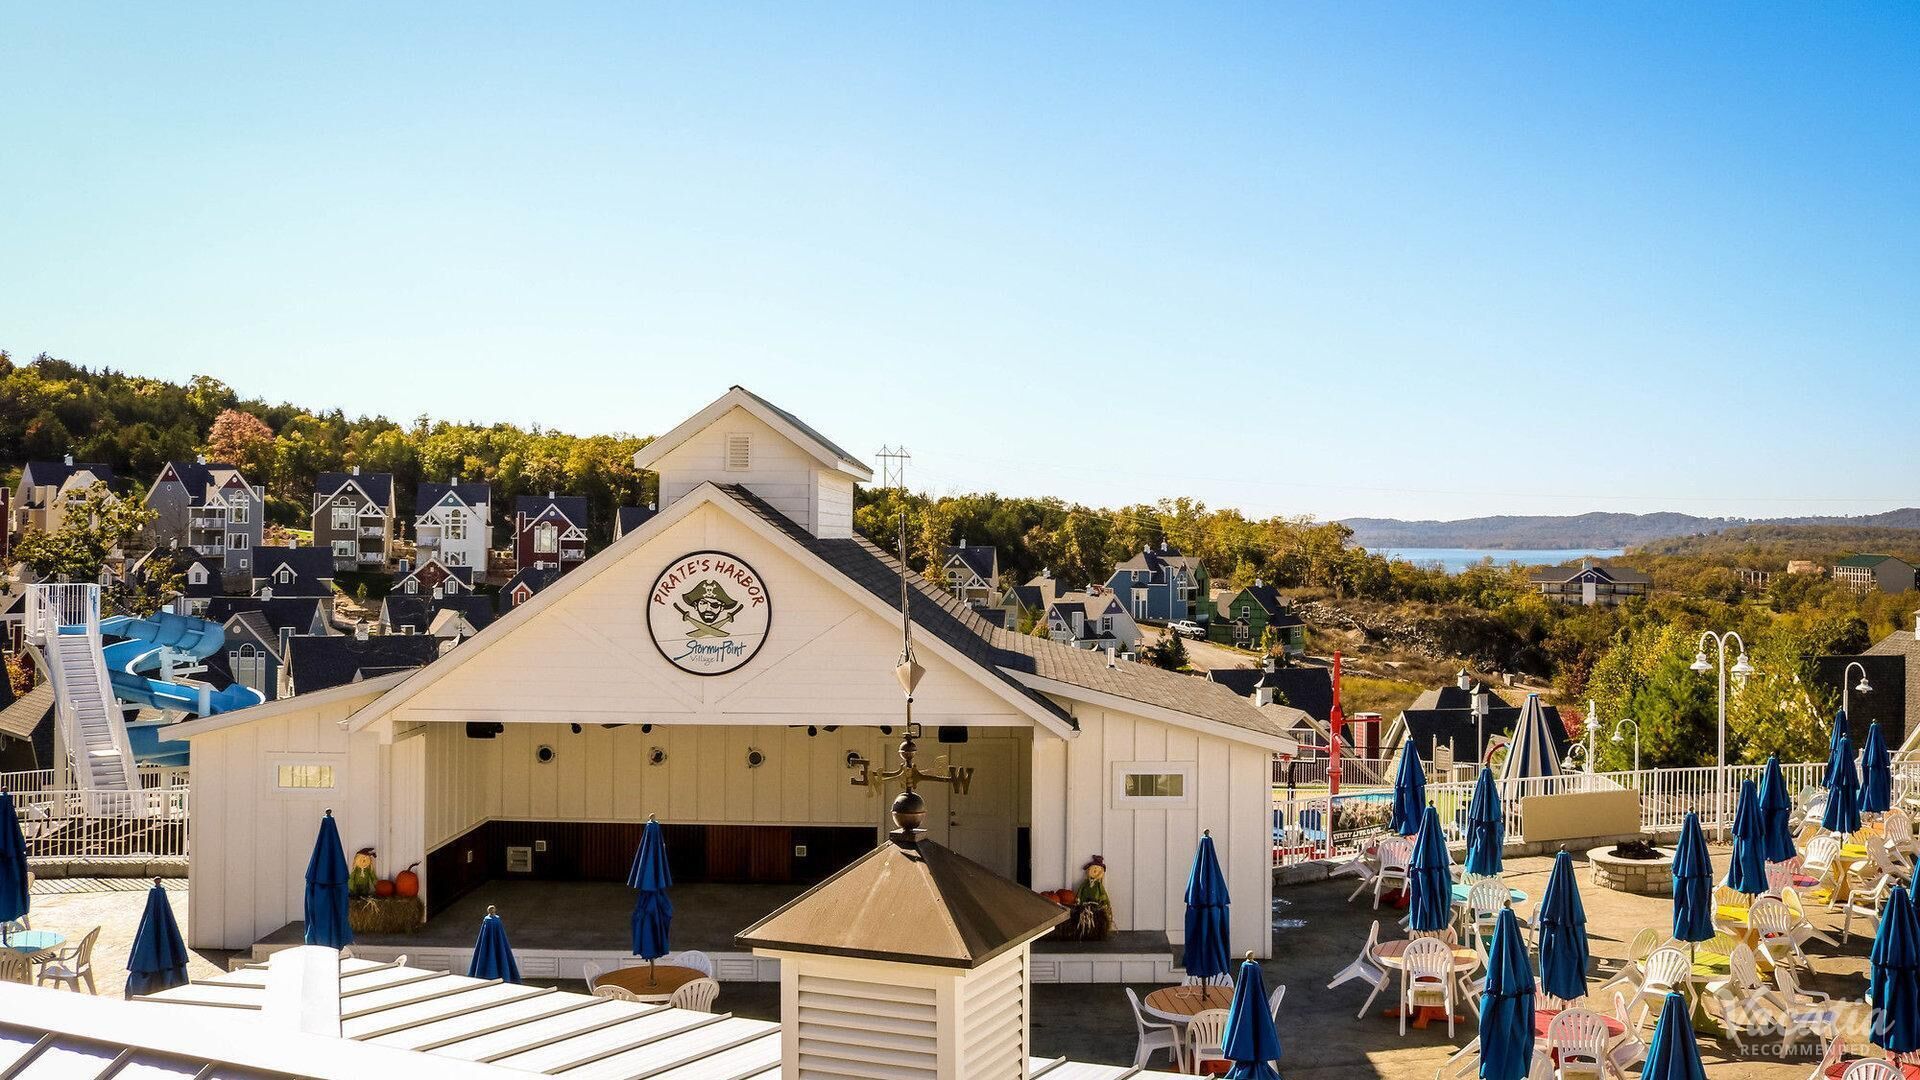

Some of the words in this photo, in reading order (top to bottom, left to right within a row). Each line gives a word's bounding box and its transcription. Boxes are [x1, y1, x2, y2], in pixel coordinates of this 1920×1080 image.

[653, 559, 710, 606] PIRATE'S
[714, 560, 765, 608] HARBOR
[674, 640, 721, 662] Stormy
[720, 640, 747, 663] Point
[689, 654, 715, 666] Village
[949, 765, 974, 795] W
